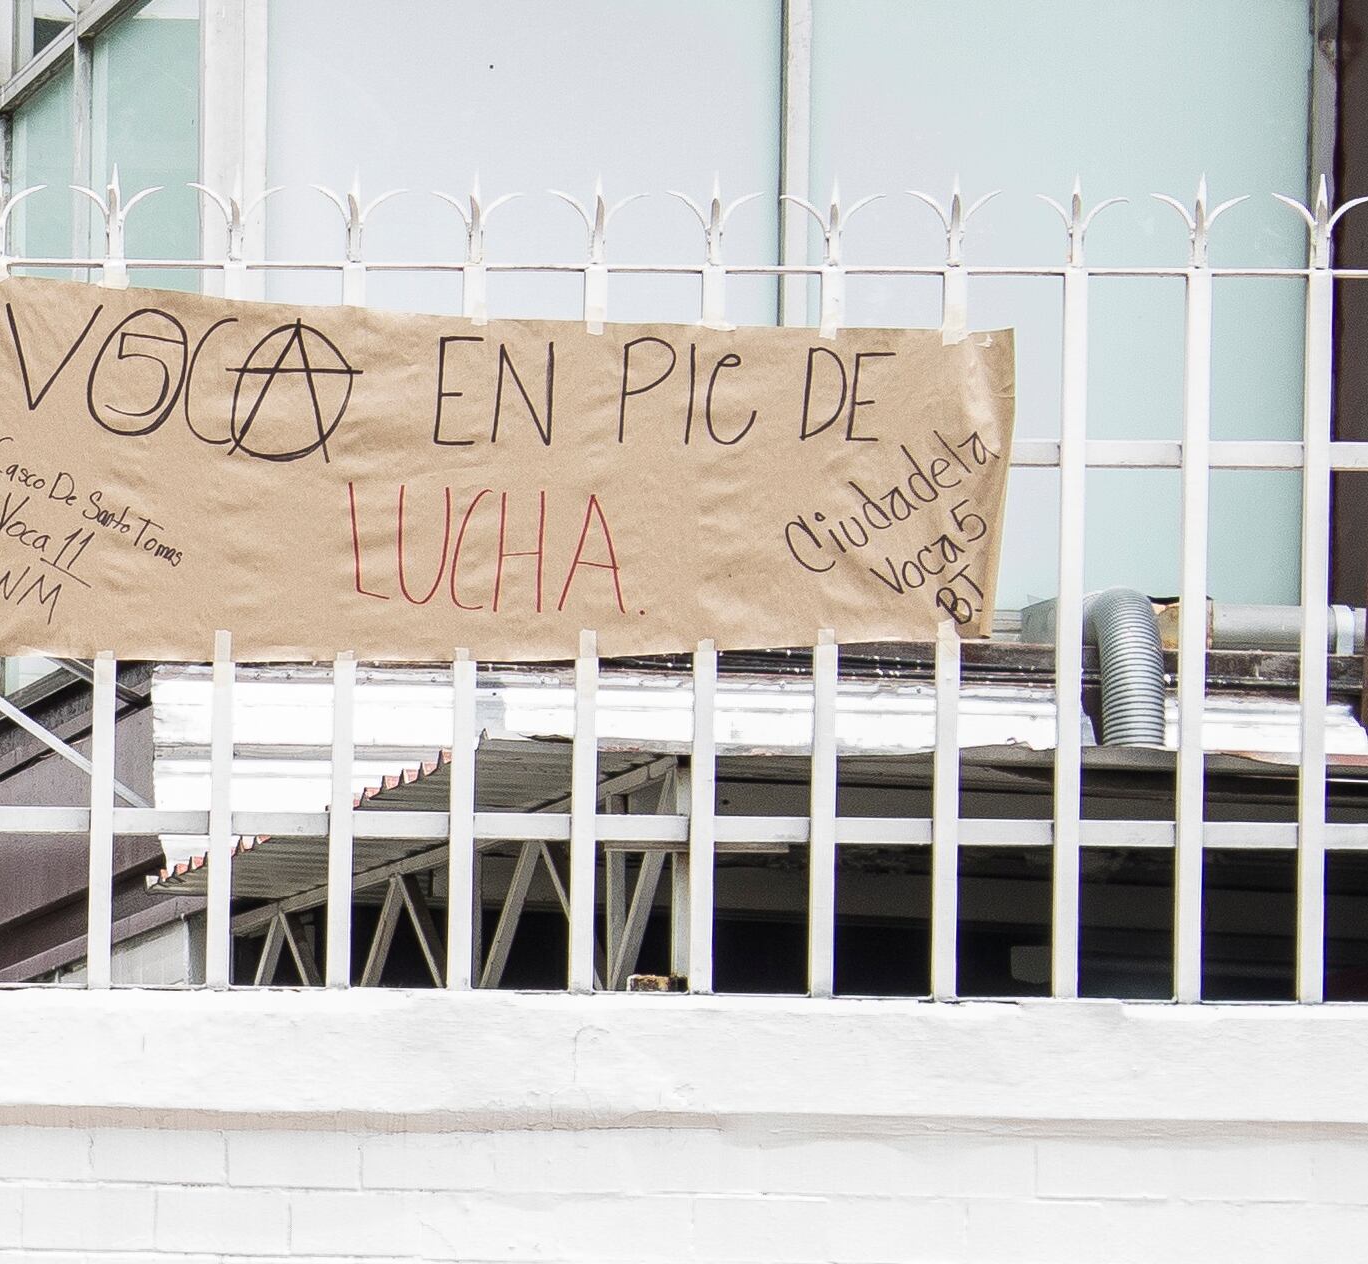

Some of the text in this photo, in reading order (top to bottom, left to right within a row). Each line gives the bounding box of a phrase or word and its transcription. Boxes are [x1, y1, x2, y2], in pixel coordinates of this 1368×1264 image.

[431, 334, 555, 447] EN
[798, 345, 899, 443] DE
[48, 471, 78, 507] De
[133, 516, 184, 567] Tomas
[784, 429, 1001, 573] Ciudadela
